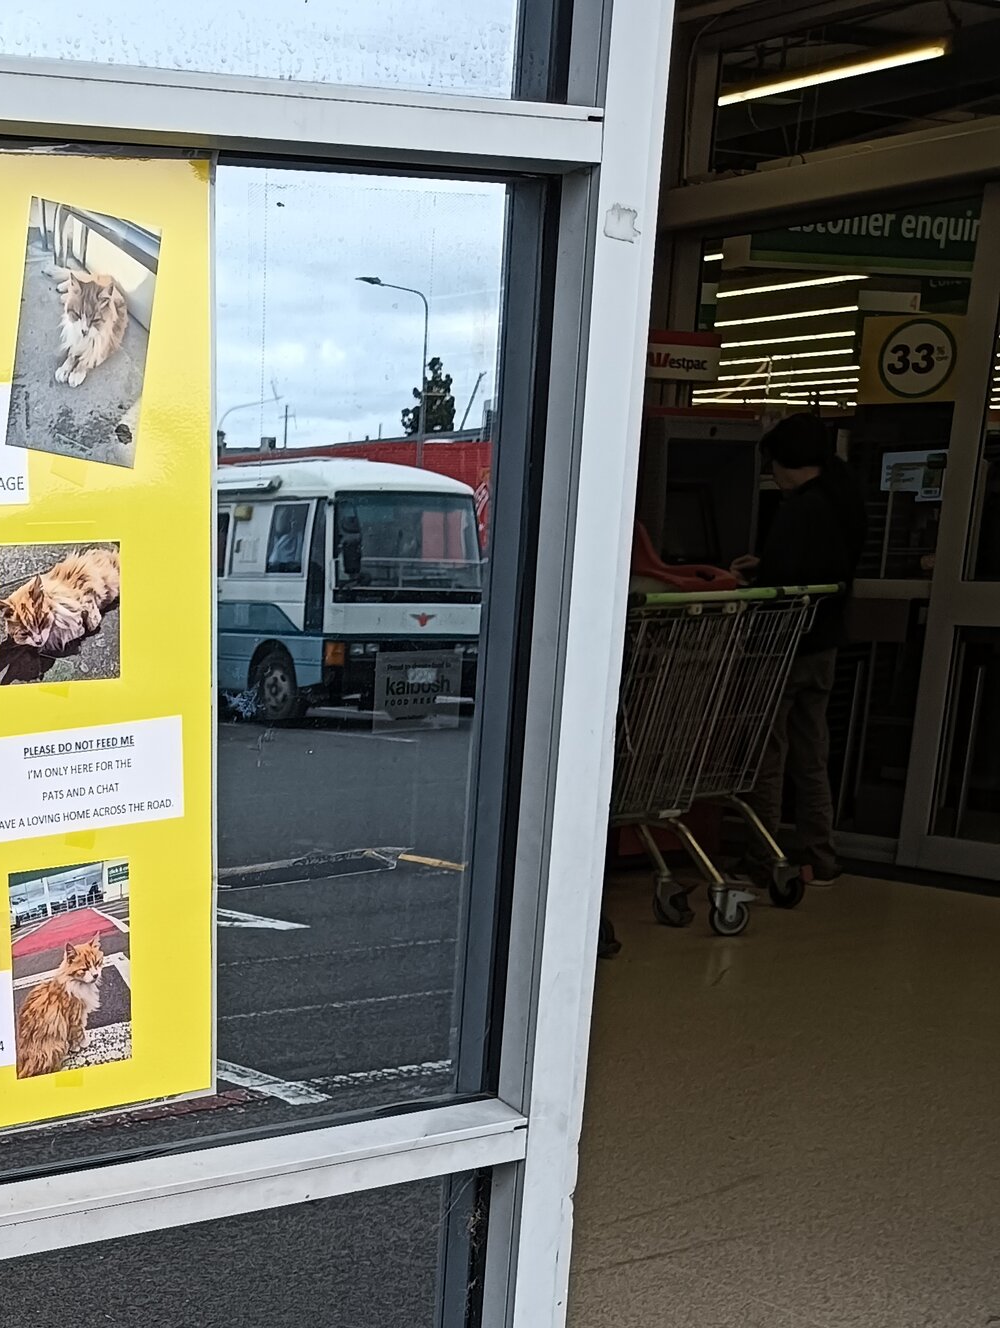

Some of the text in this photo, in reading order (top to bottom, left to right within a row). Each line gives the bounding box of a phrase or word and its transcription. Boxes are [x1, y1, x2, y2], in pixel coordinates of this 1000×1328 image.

[648, 351, 708, 372] Westpac
[887, 343, 935, 375] 33
[22, 734, 135, 758] PLEASE DO NOT FEED ME
[27, 757, 132, 780] I'M ONLY HERE FOR THE
[41, 781, 120, 801] PATS AND A CHAT
[17, 817, 26, 828] A
[26, 812, 61, 827] LOVING
[62, 808, 91, 822] HOME
[91, 803, 127, 818] ACROSS
[127, 801, 145, 813] THE
[146, 798, 174, 810] ROAD.
